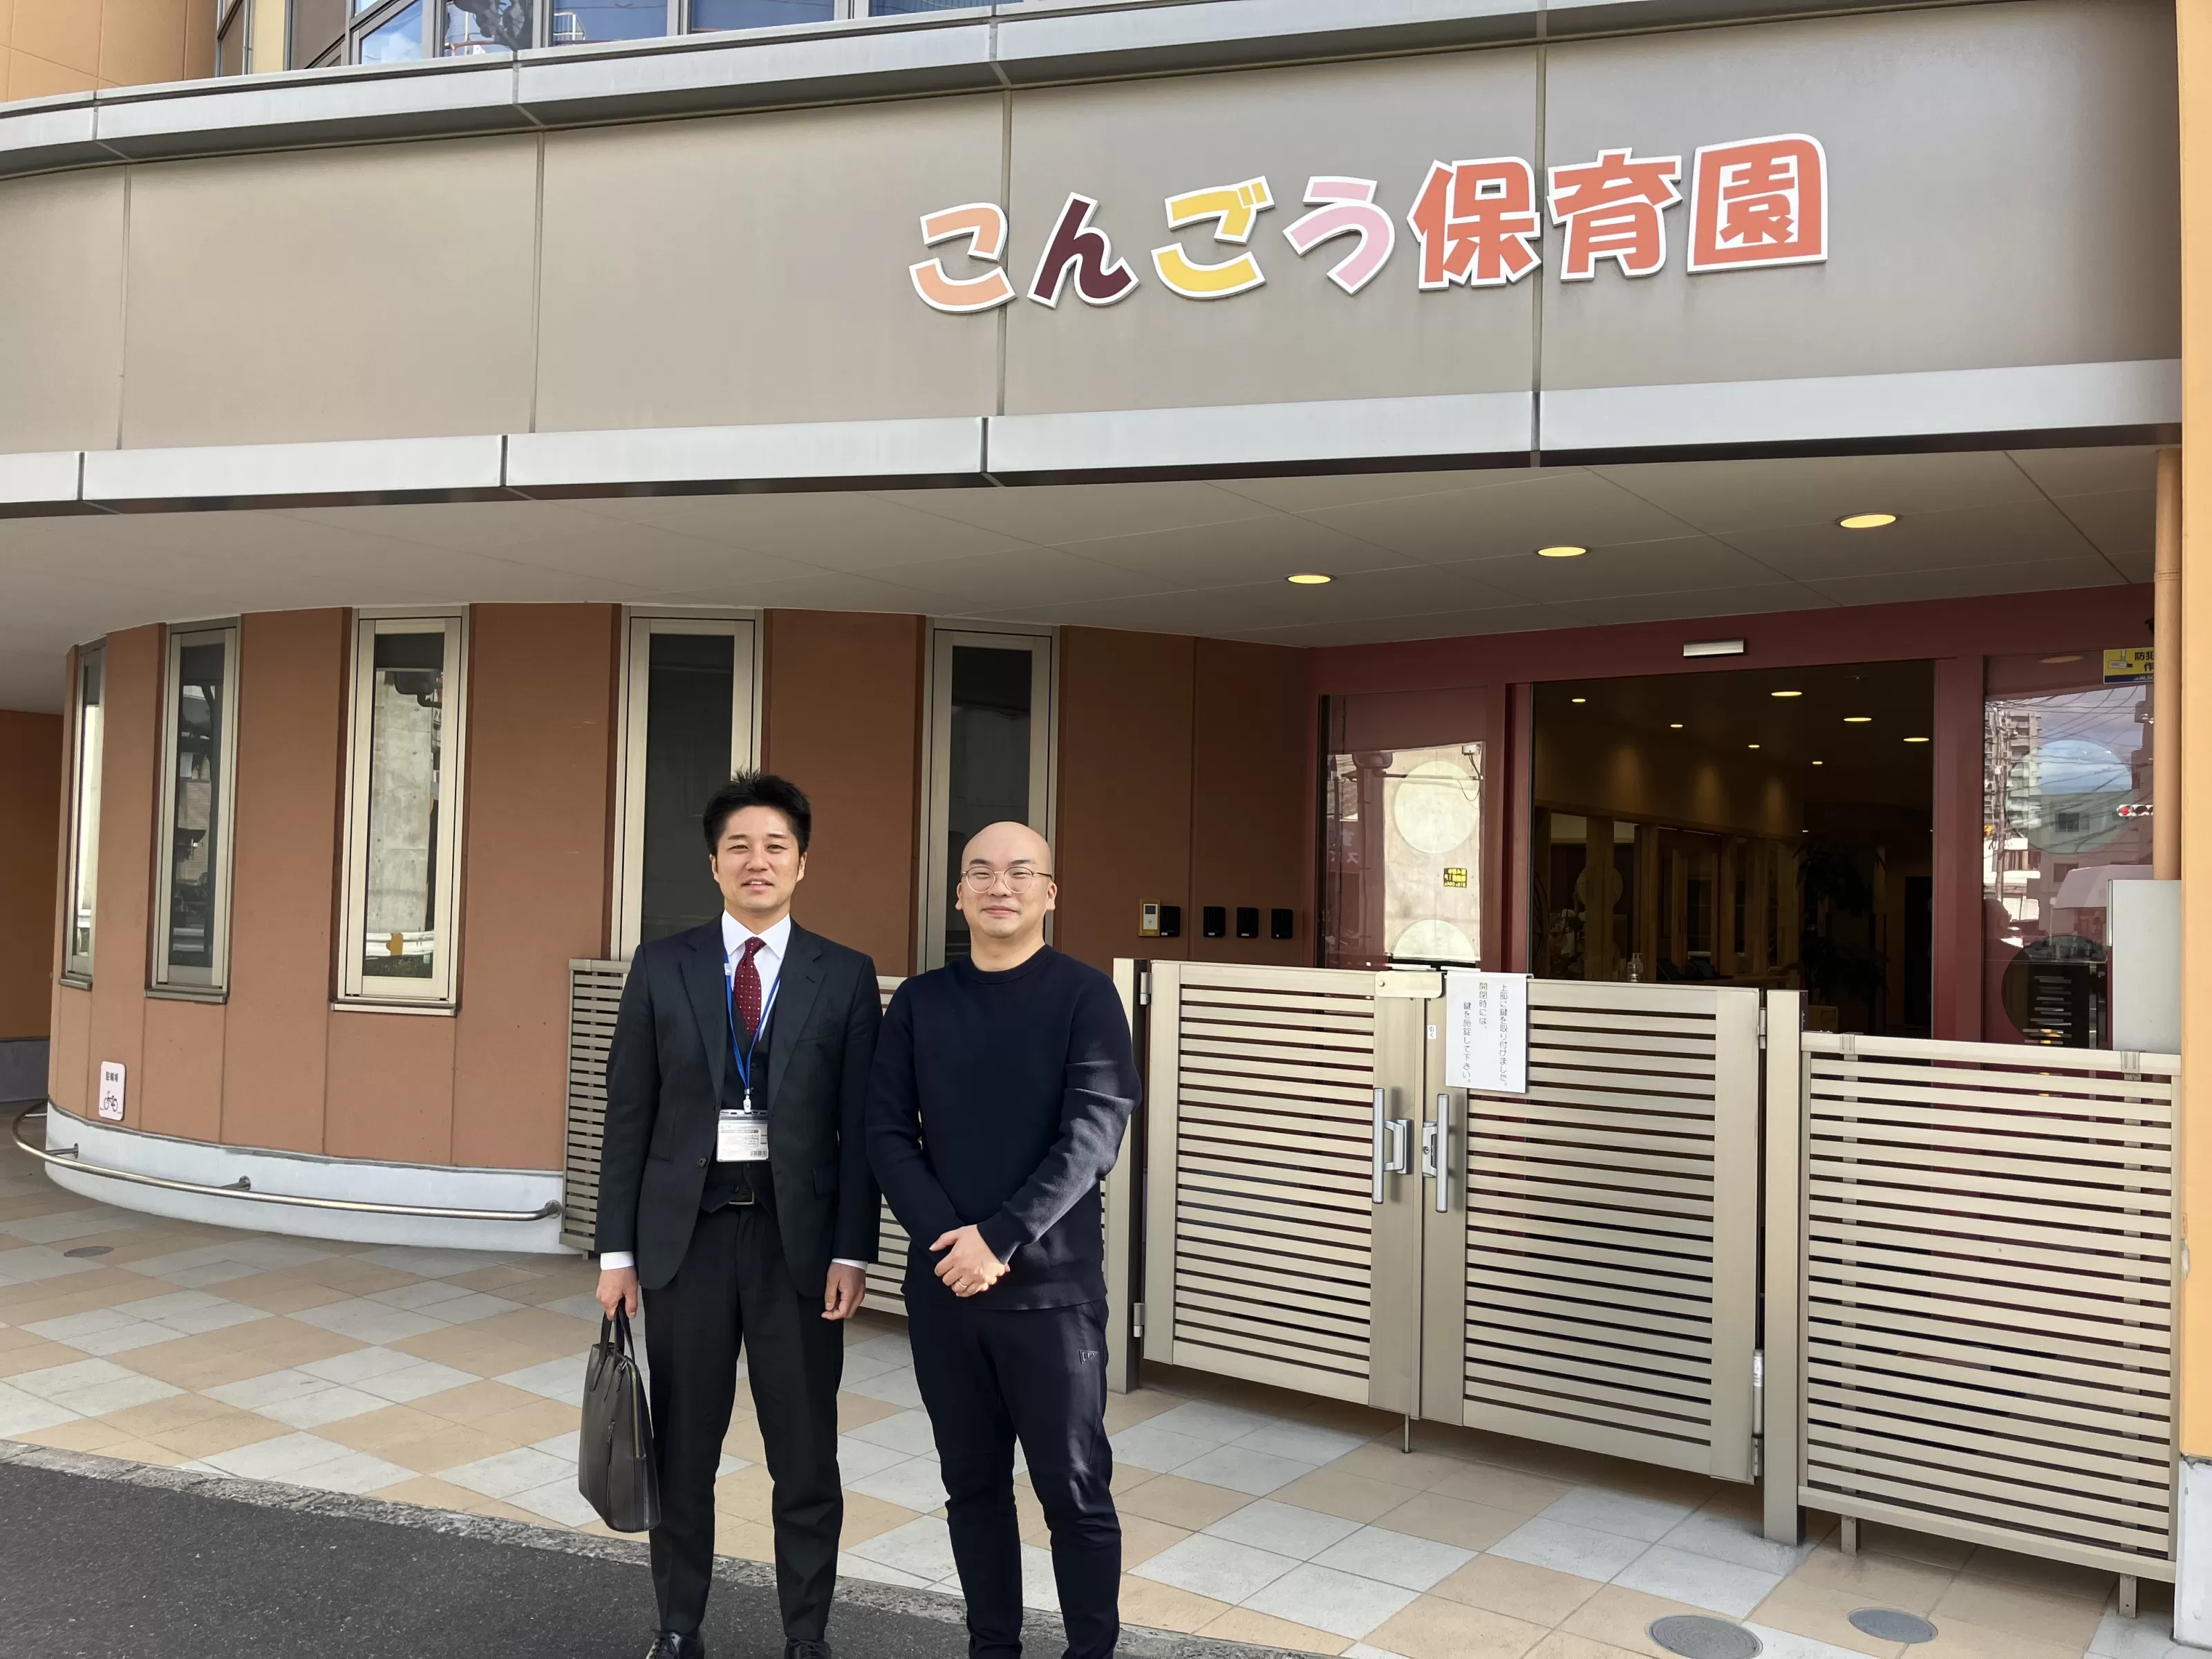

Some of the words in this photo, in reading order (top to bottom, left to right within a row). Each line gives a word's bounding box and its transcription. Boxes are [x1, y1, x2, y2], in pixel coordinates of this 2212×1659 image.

[909, 133, 1828, 313] こんごう保育園
